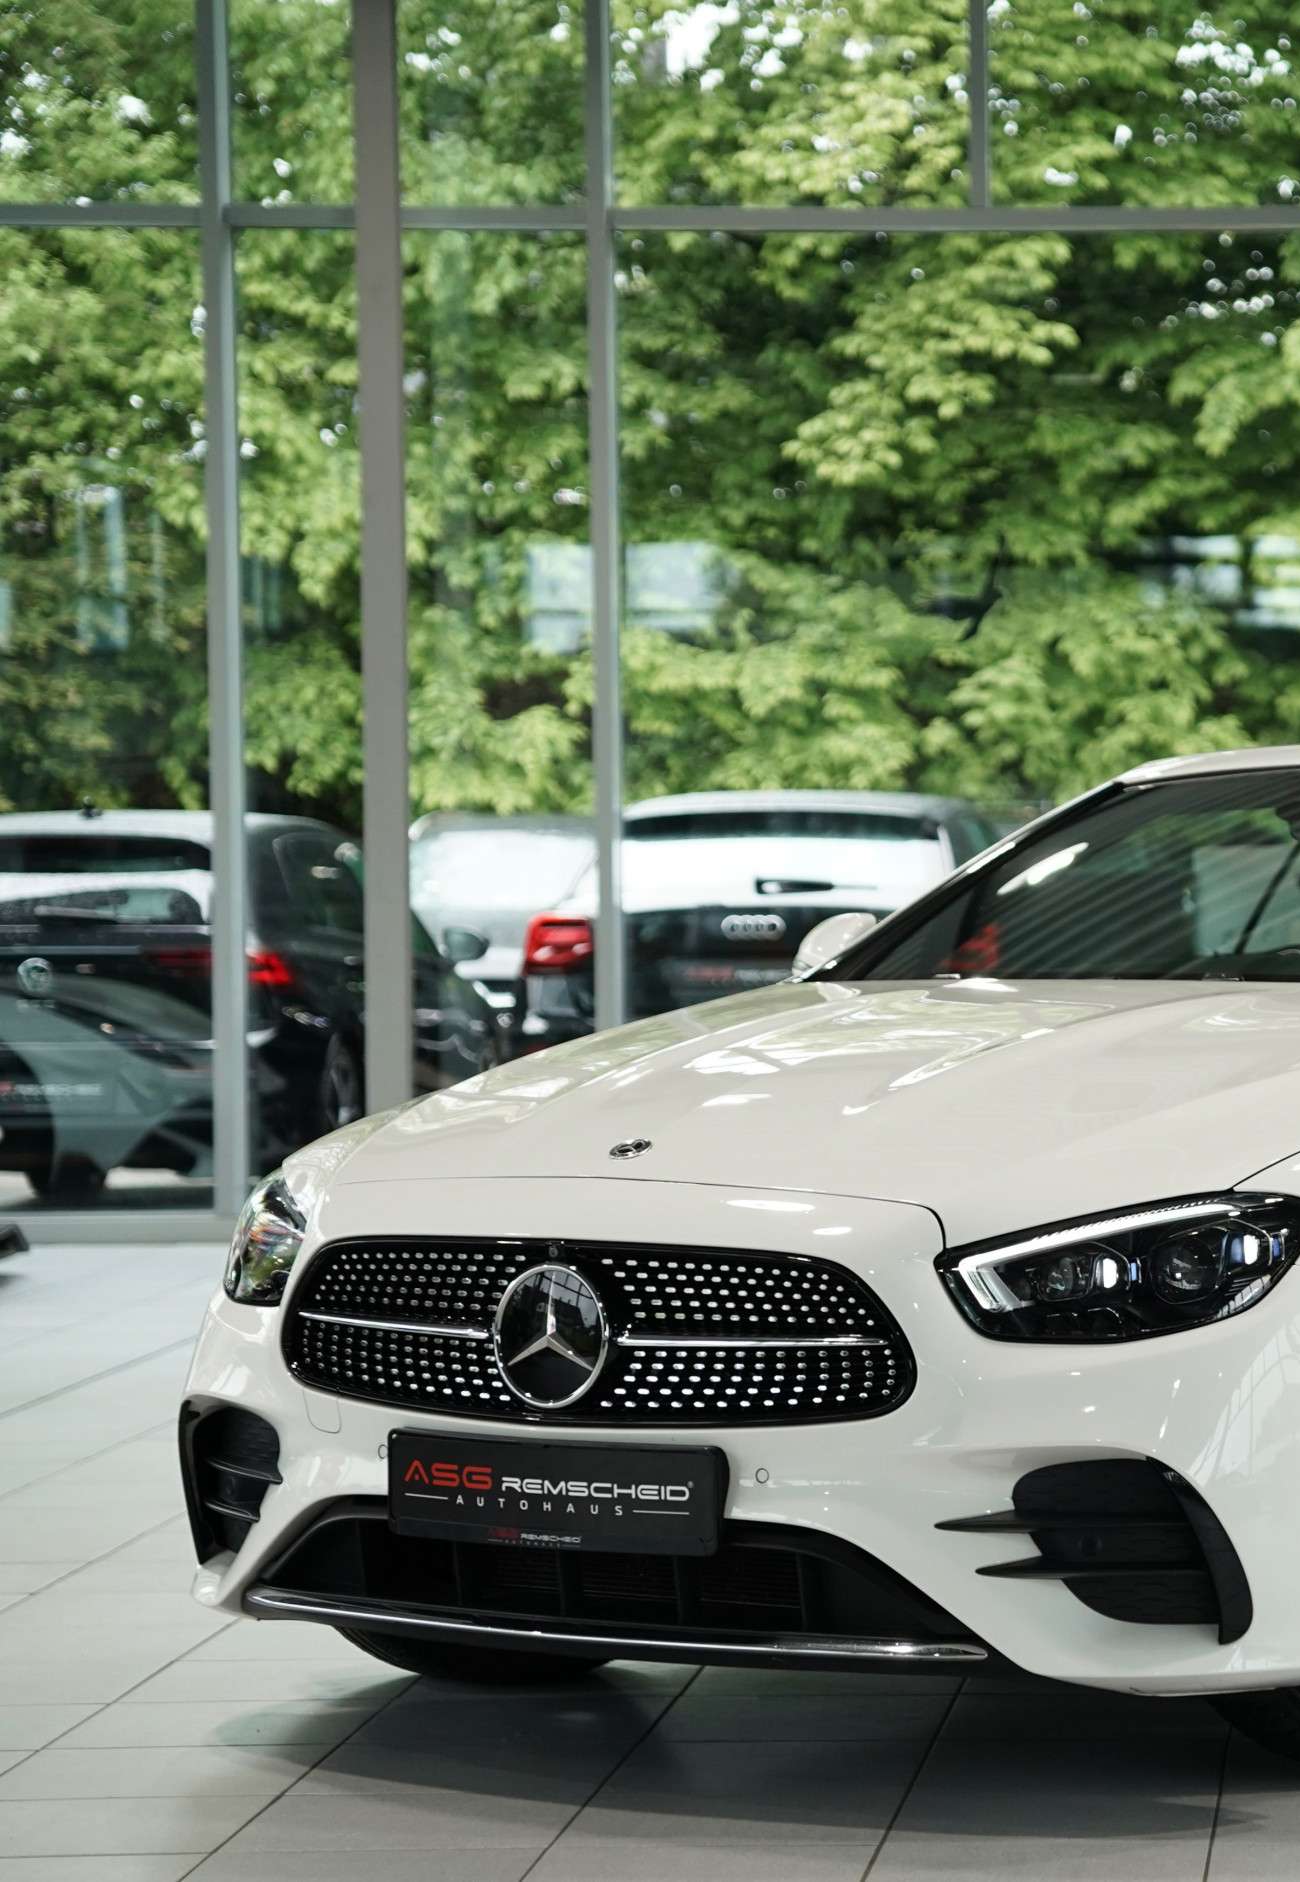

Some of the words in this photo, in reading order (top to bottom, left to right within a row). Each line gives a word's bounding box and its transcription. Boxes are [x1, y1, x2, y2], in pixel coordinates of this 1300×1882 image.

[404, 1459, 493, 1491] ASG
[501, 1475, 690, 1502] REMSCHEID
[456, 1494, 624, 1517] AUTOHAUS
